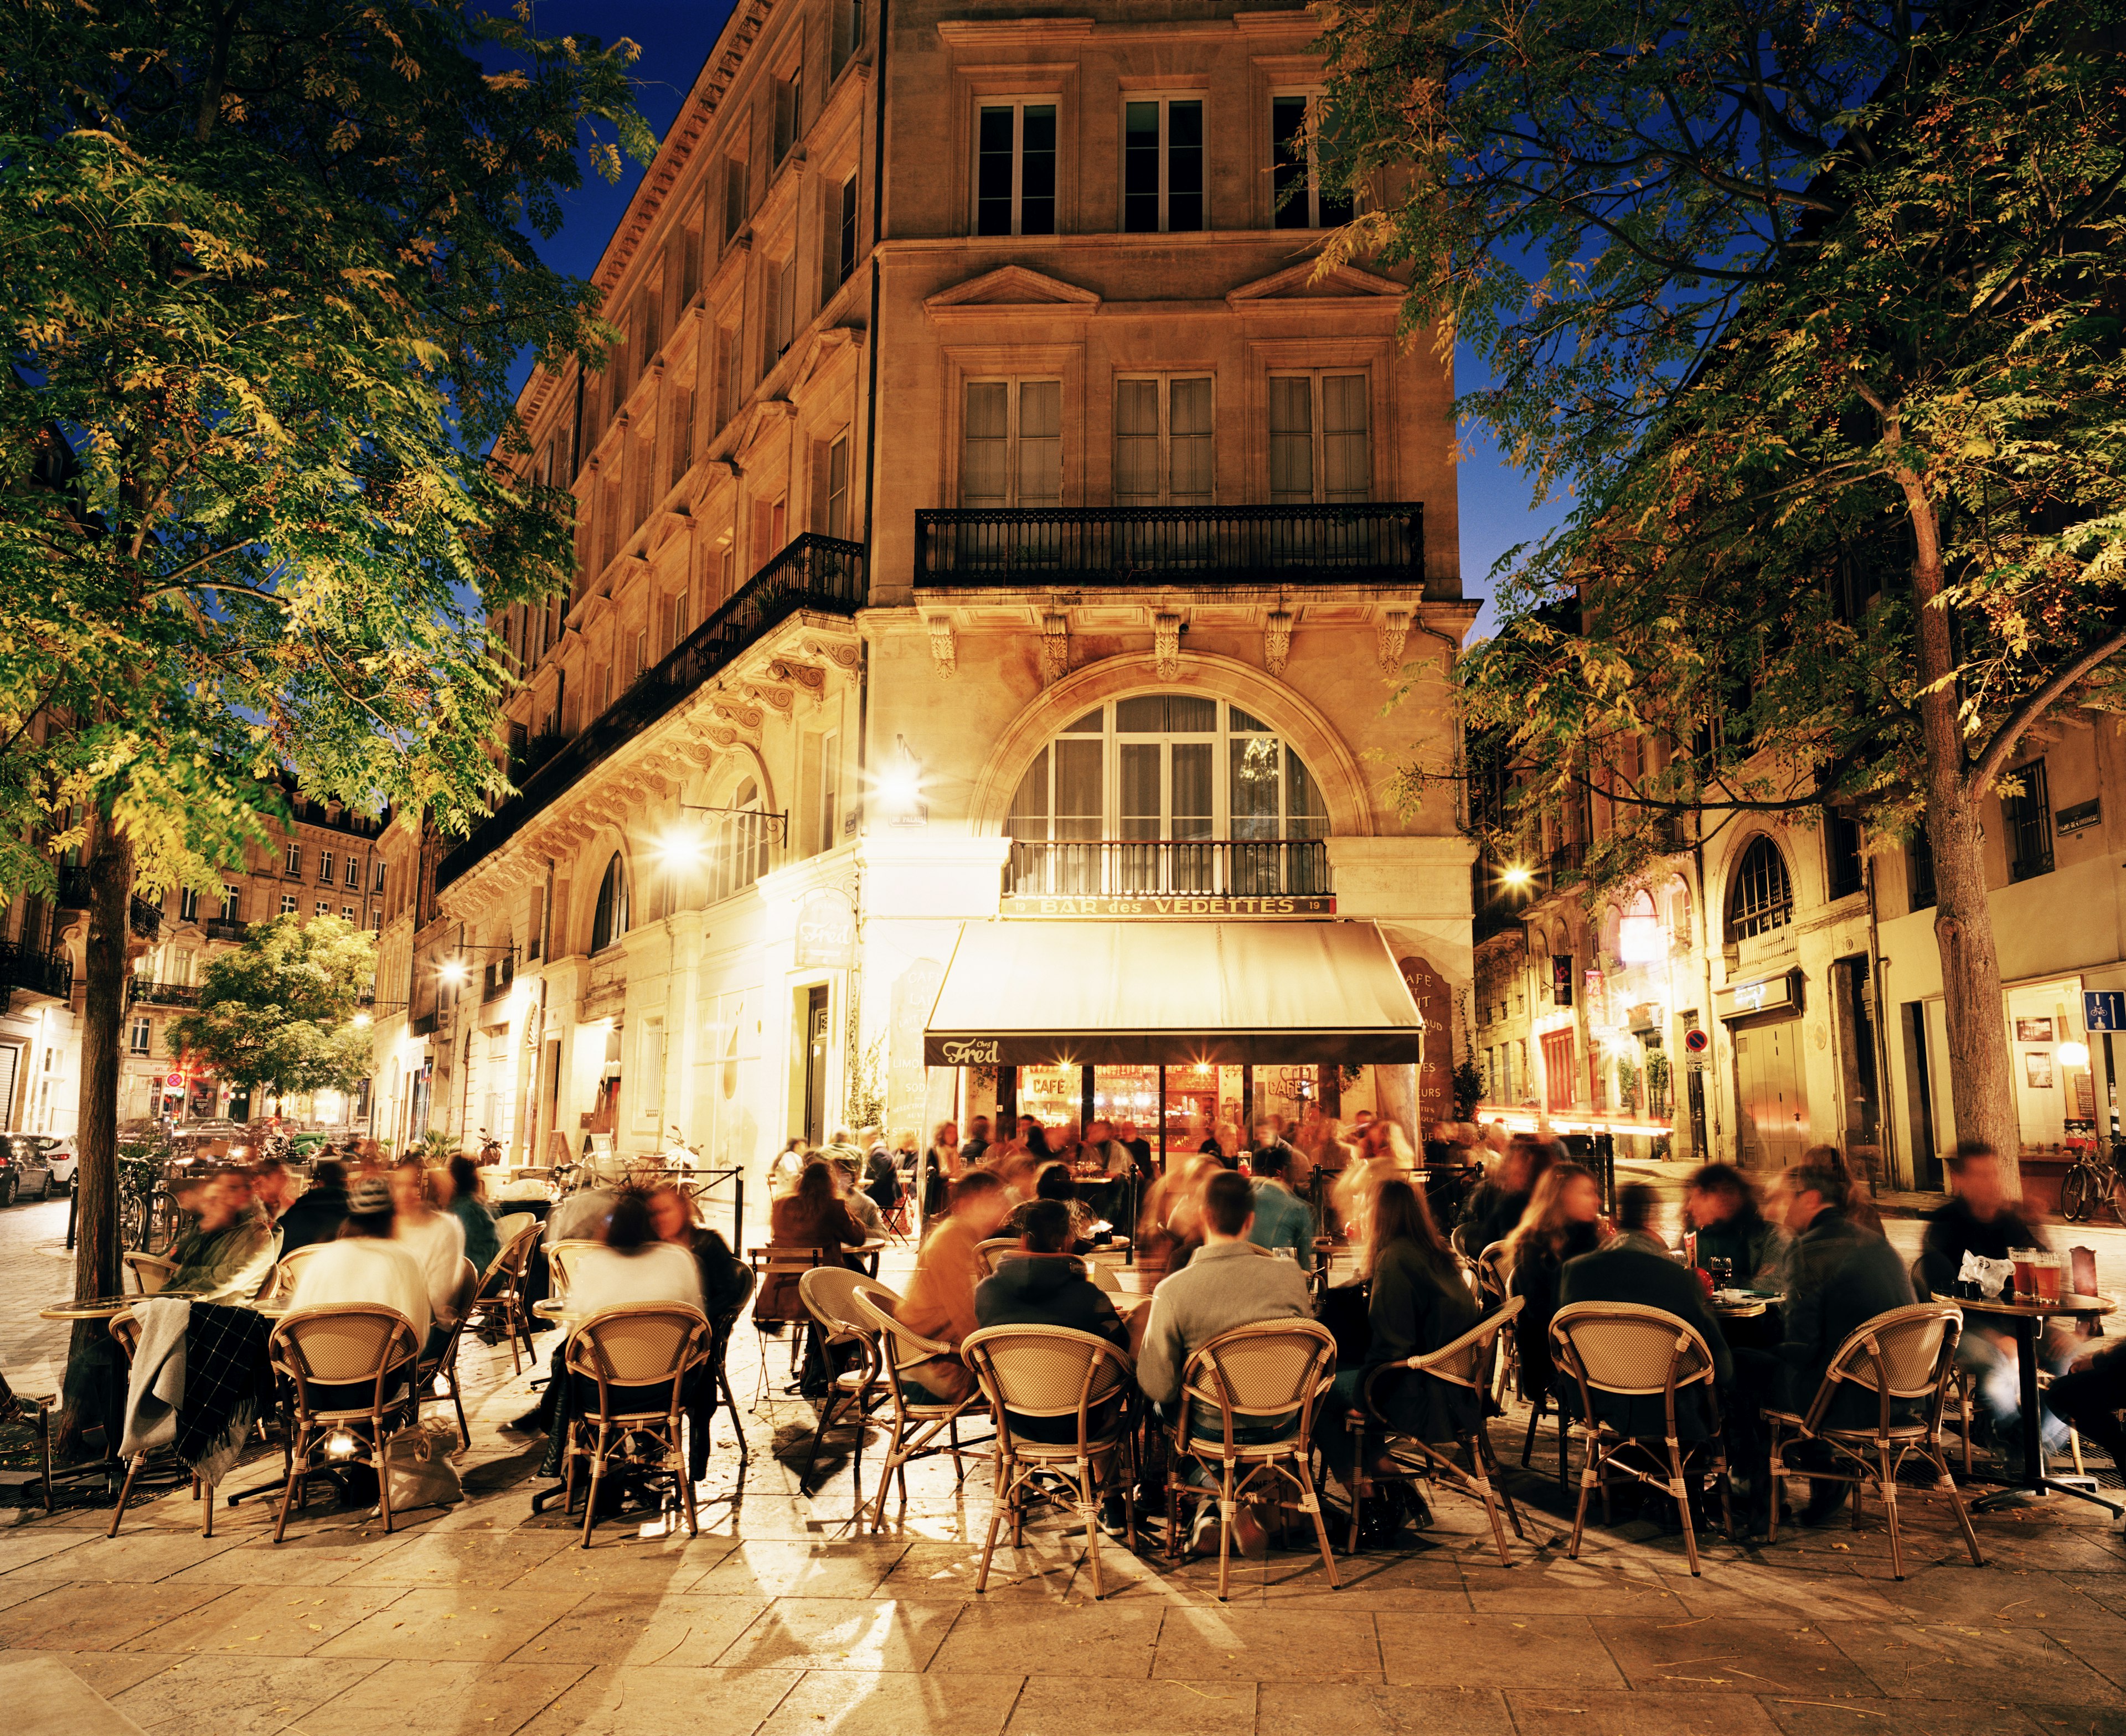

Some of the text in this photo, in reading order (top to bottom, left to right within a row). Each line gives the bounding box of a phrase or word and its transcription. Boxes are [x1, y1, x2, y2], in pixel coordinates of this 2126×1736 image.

[1015, 902, 1025, 912] 19
[1040, 900, 1097, 913] BAR
[1108, 901, 1142, 913] des
[1154, 900, 1294, 913] VEDETTES
[801, 921, 851, 945] Fred
[1406, 974, 1432, 987] AFE
[910, 994, 935, 1006] LAI
[942, 1038, 1000, 1063] Fred
